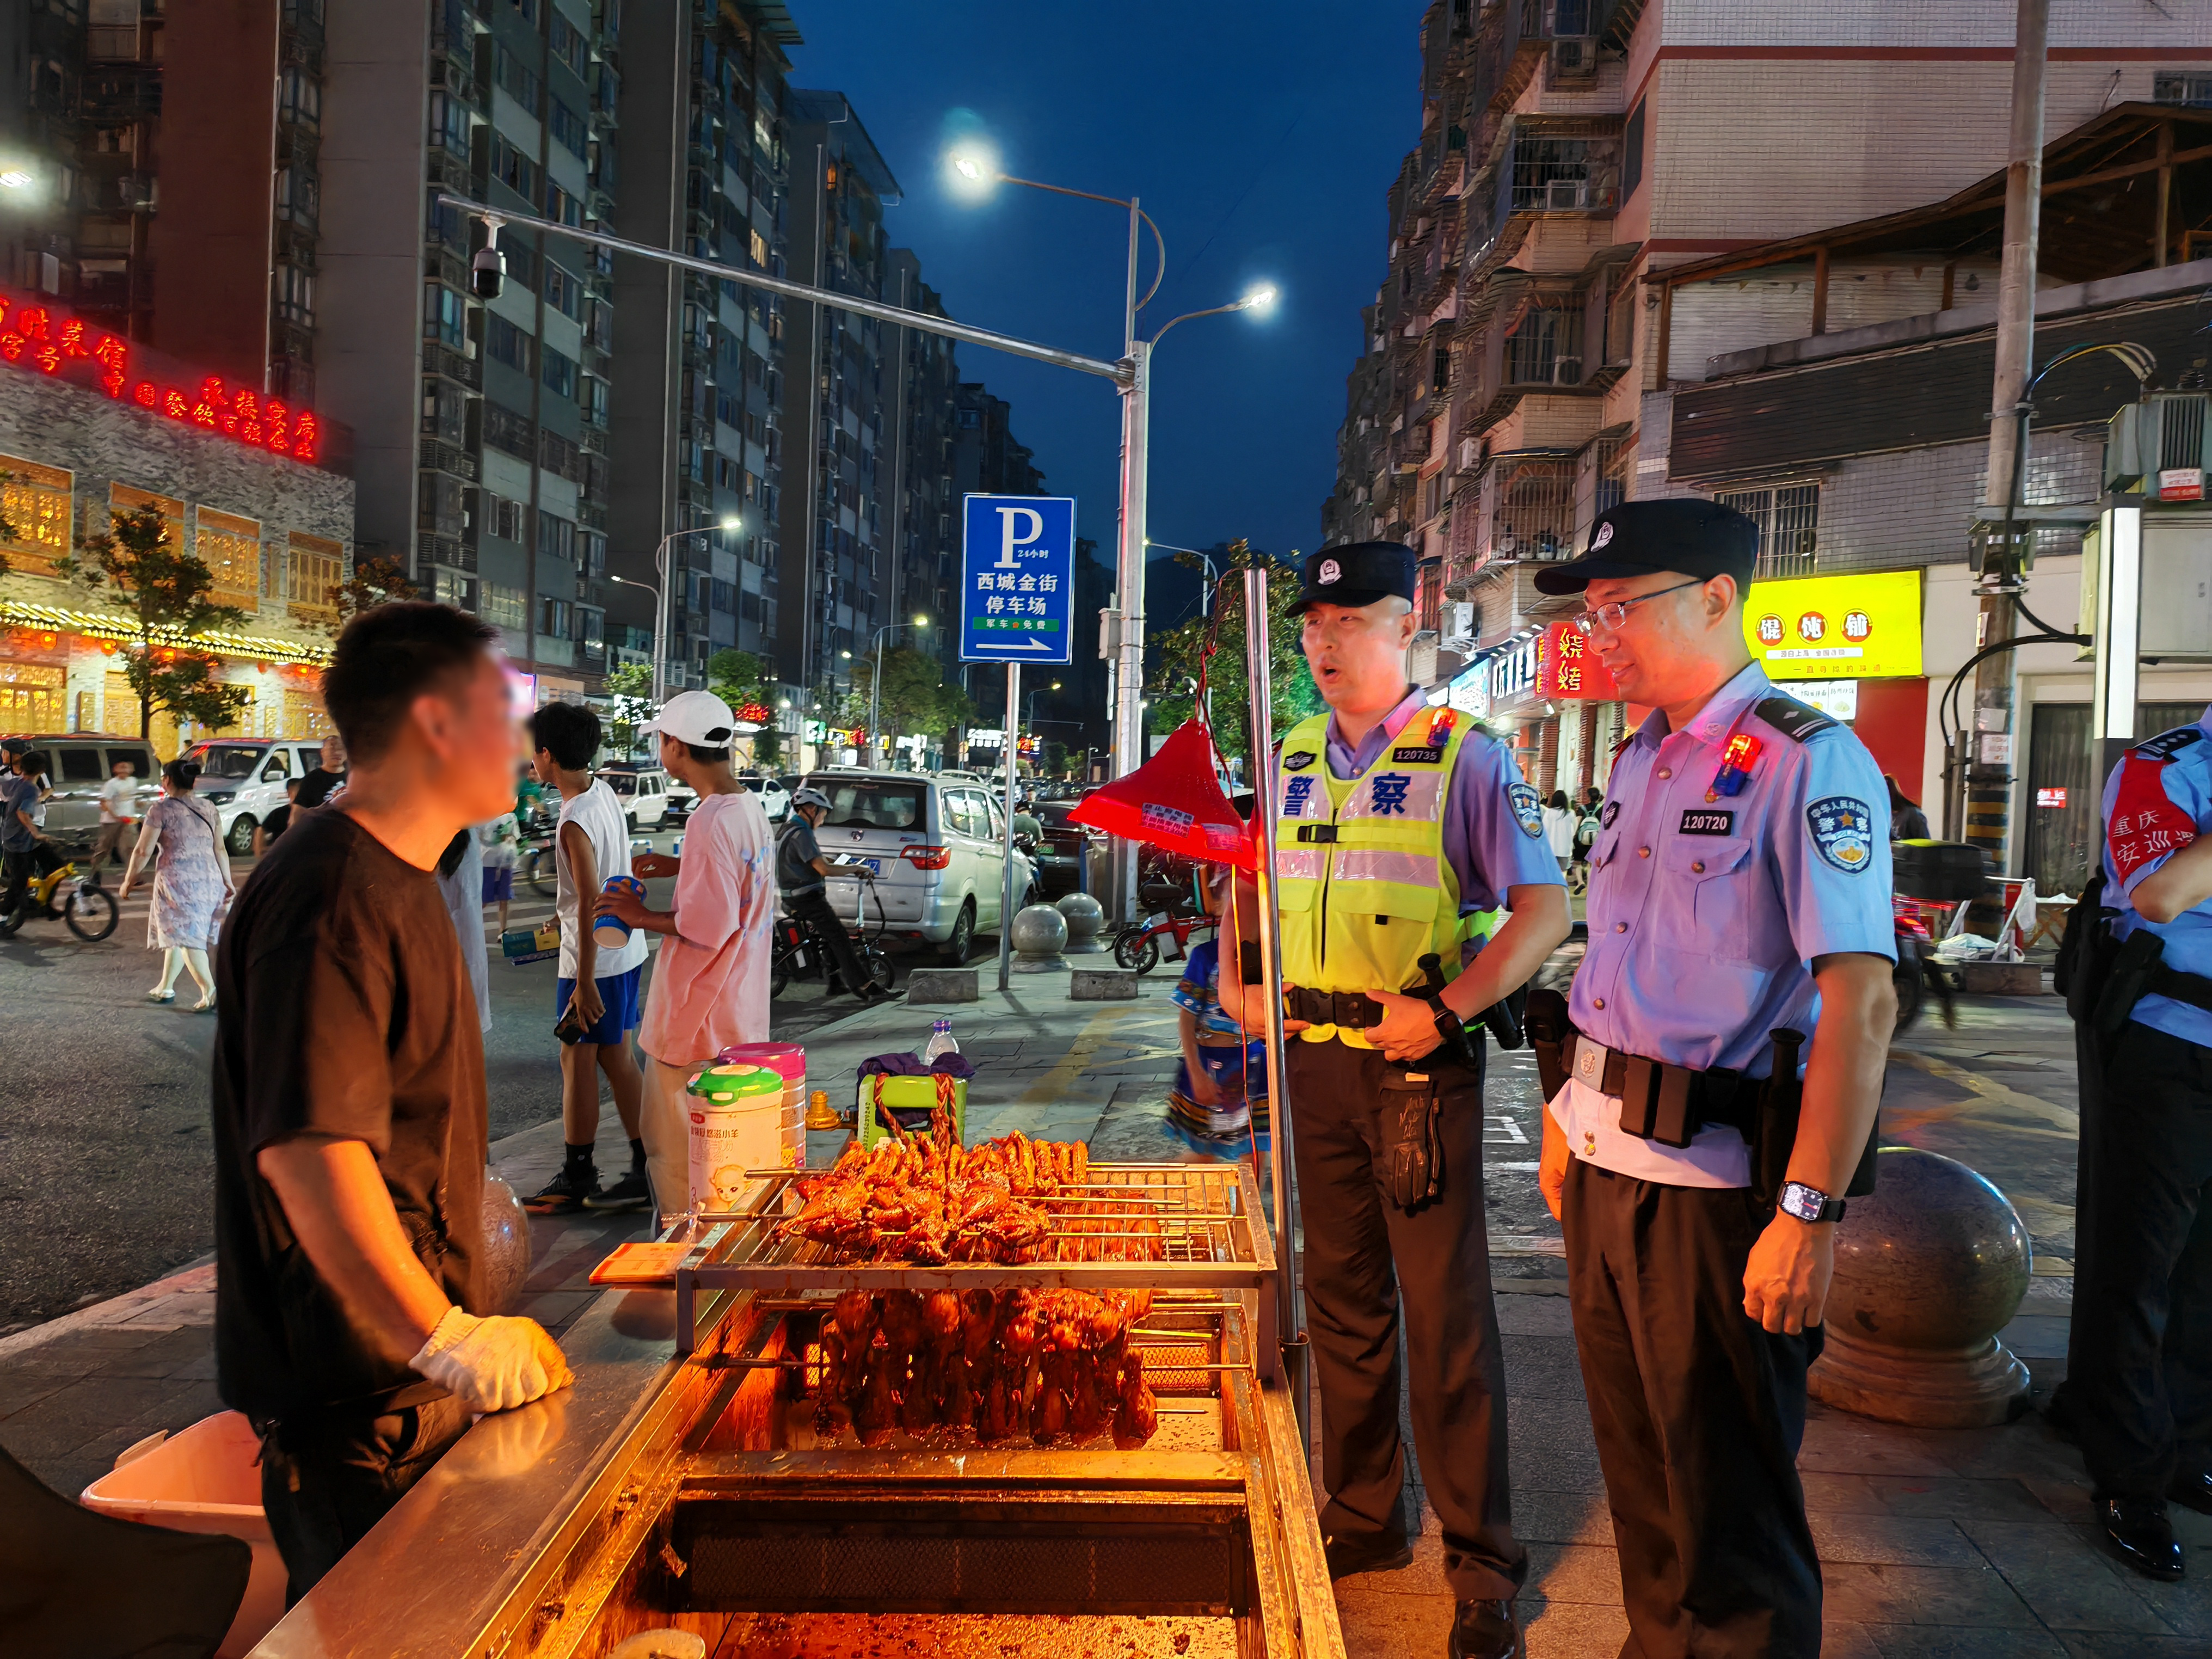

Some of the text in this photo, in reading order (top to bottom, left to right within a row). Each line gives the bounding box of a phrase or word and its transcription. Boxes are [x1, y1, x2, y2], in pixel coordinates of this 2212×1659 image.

[994, 507, 1043, 568] P
[1017, 549, 1049, 558] 24小时
[977, 573, 1058, 592] 西城金街
[985, 595, 1046, 616] 停车场
[1557, 628, 1583, 691] 烧烤
[1396, 750, 1437, 760] 120735
[1283, 772, 1411, 816] 警 察
[1683, 815, 1728, 831] 120720
[2112, 810, 2160, 838] 重庆
